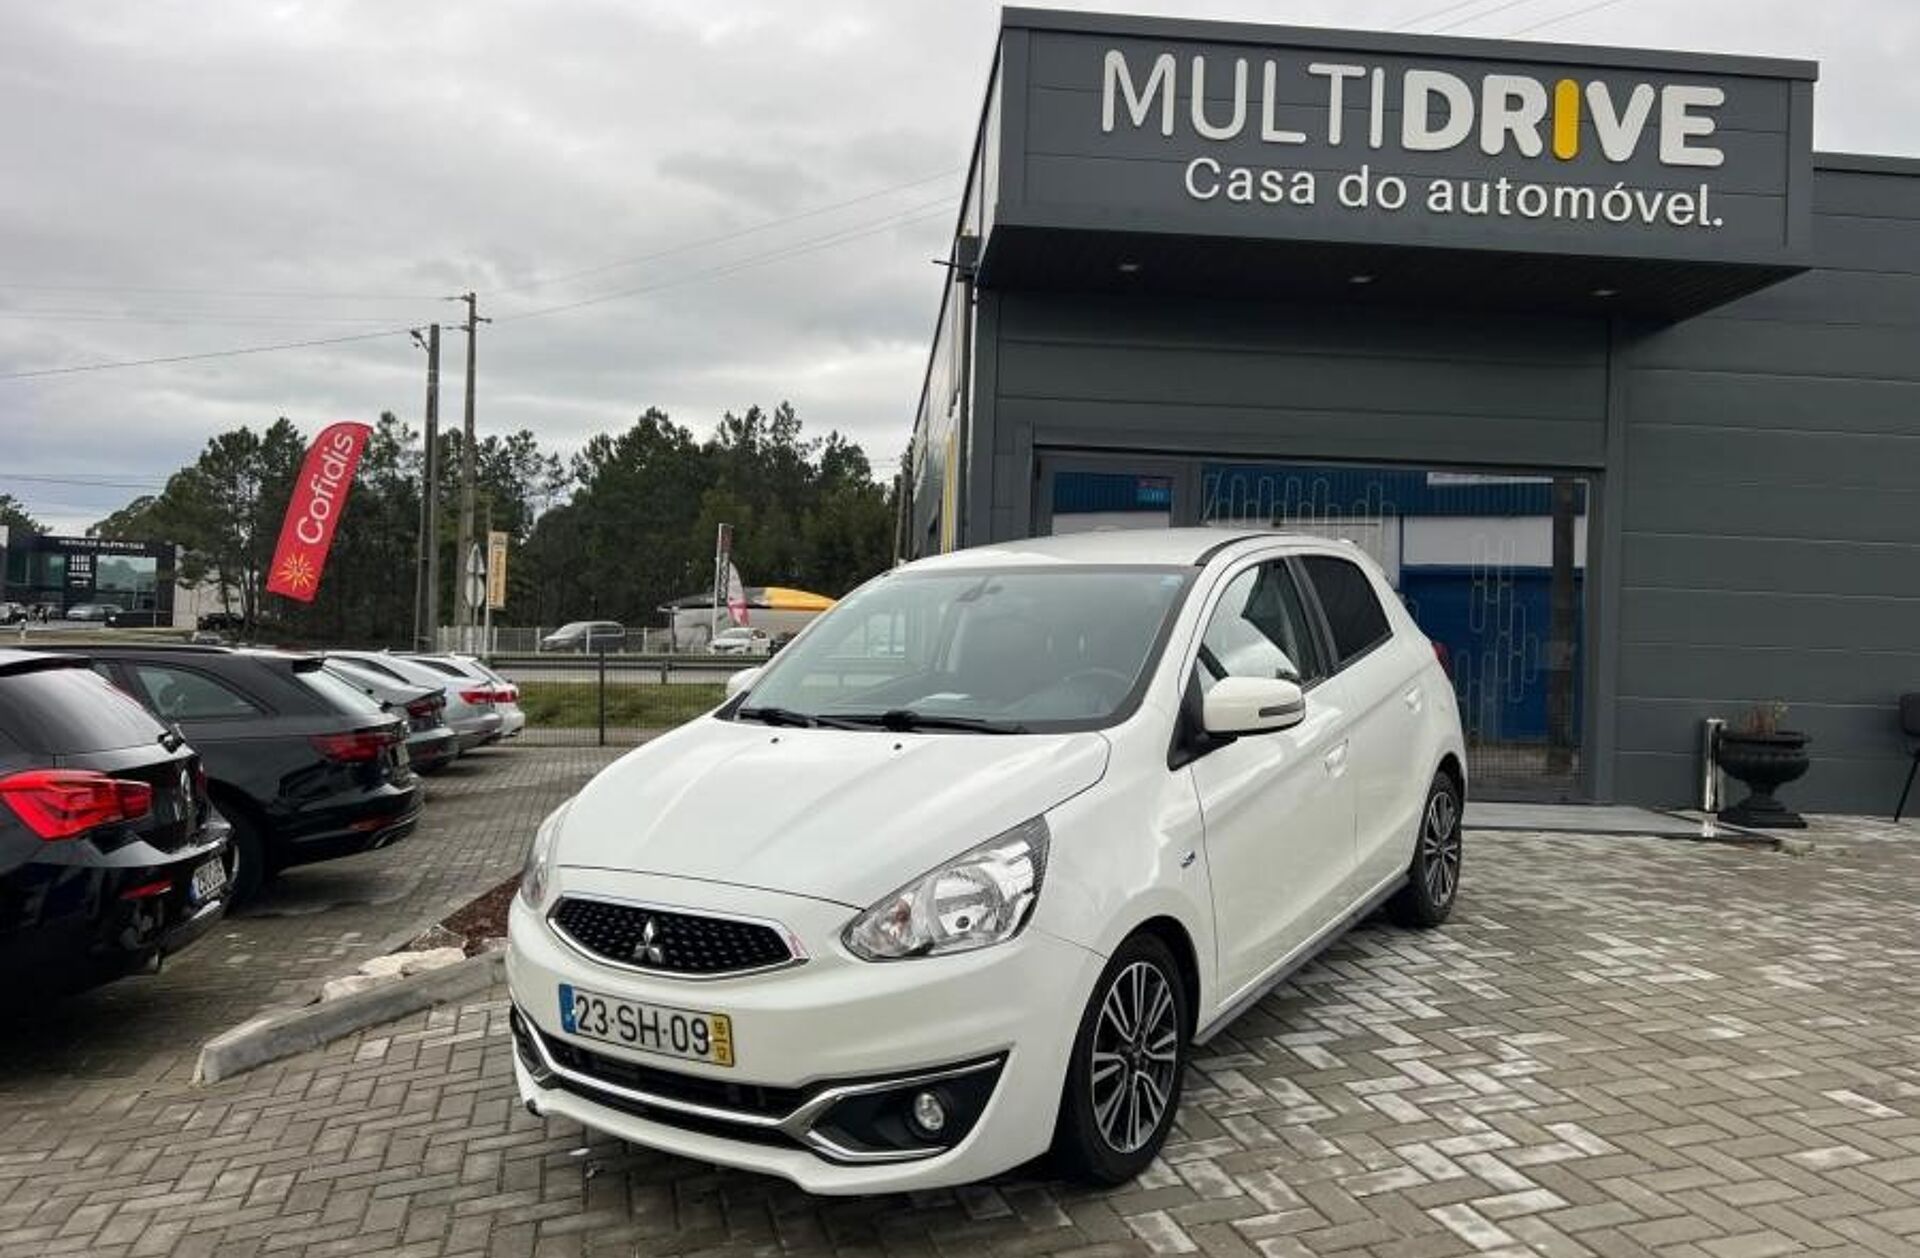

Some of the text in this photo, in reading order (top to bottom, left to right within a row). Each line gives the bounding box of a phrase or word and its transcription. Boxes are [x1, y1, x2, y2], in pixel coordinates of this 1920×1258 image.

[1102, 50, 1725, 167] MULTIDRIVE
[1185, 157, 1724, 227] Casa do automóvel.
[297, 432, 354, 544] Cofidis
